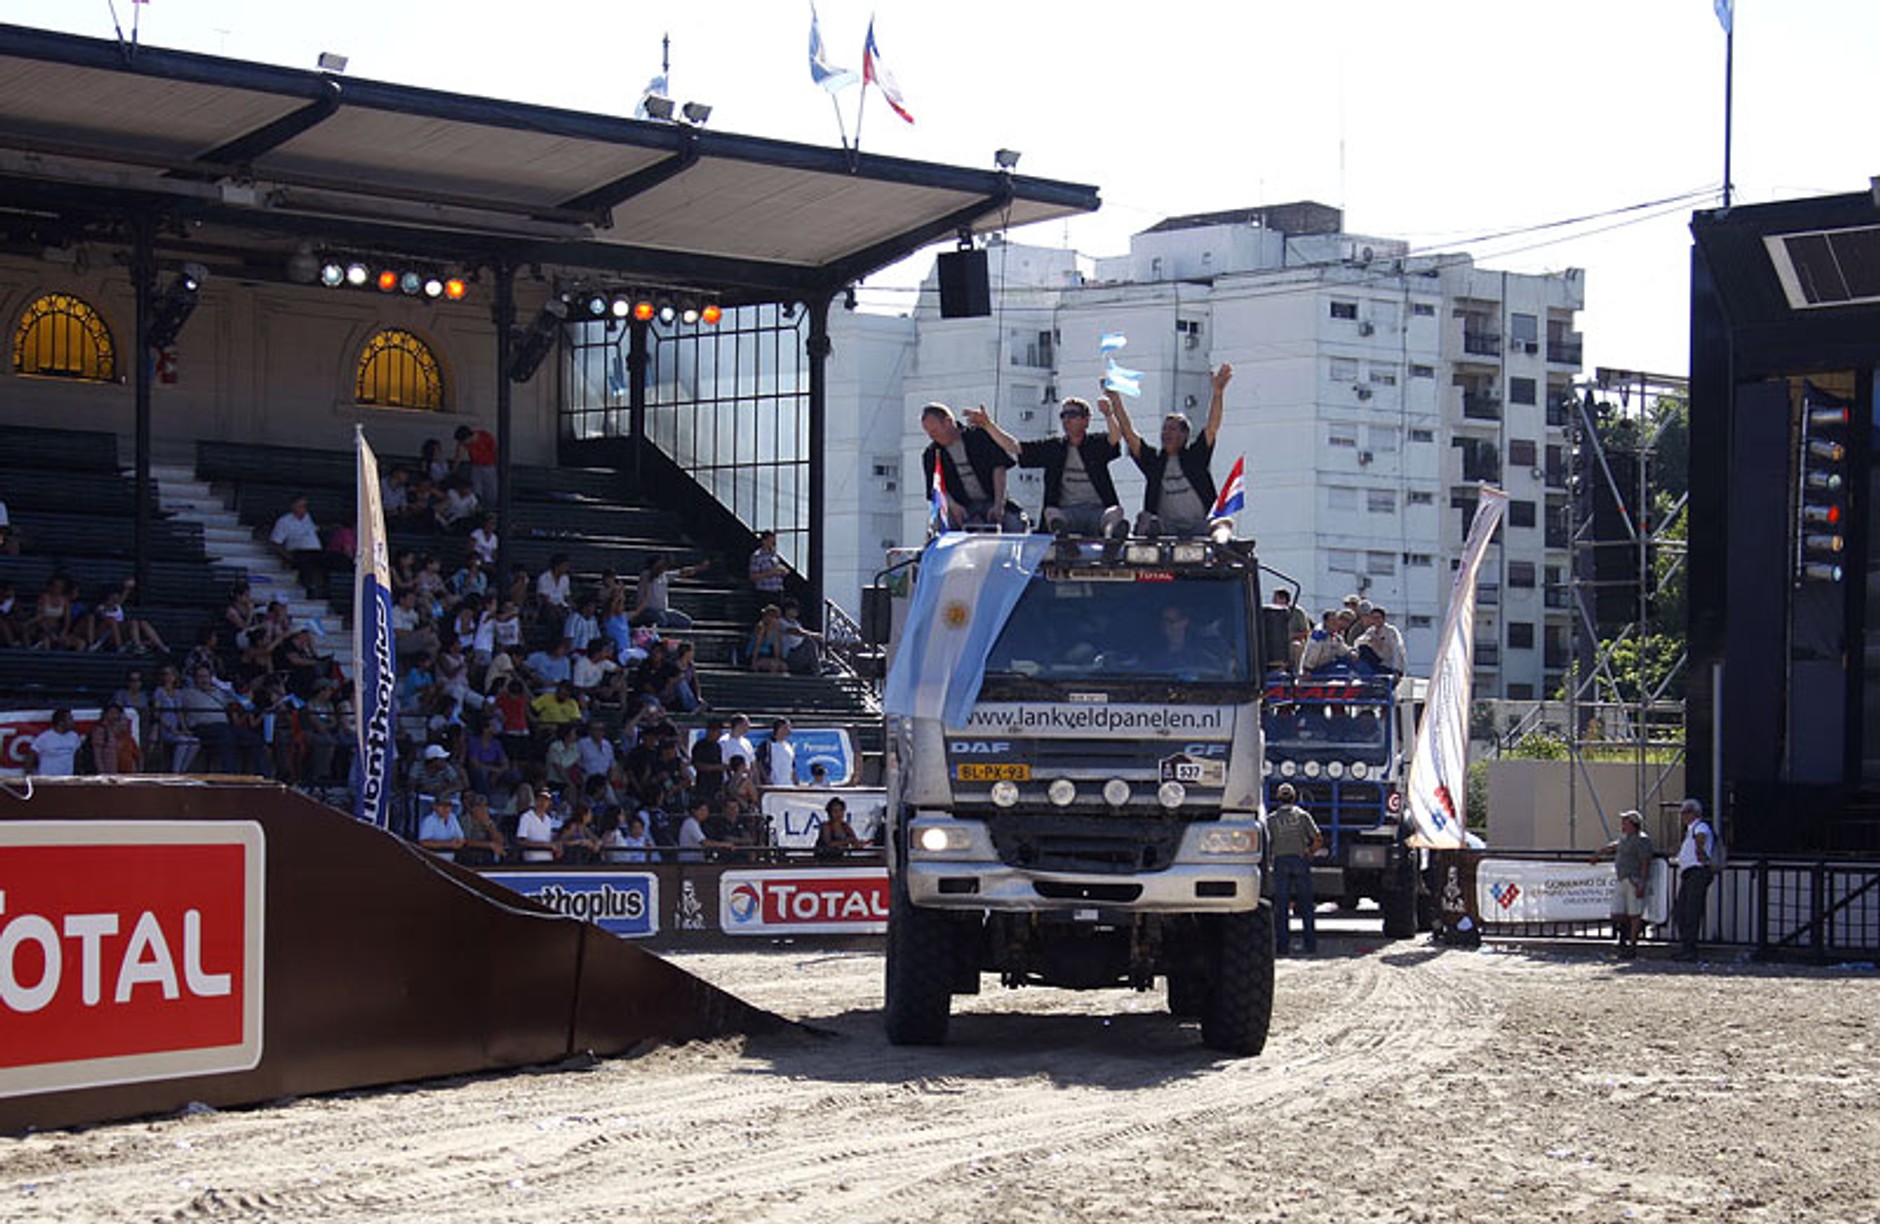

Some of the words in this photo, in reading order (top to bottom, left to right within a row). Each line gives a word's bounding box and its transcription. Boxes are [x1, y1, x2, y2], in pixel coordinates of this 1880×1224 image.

[966, 706, 1221, 731] www.lankveldpanelen.nl
[950, 742, 1010, 753] DAF
[1184, 744, 1226, 756] CF
[784, 811, 852, 835] LA
[767, 885, 889, 920] TOTAL
[0, 889, 232, 1013] OTAL
